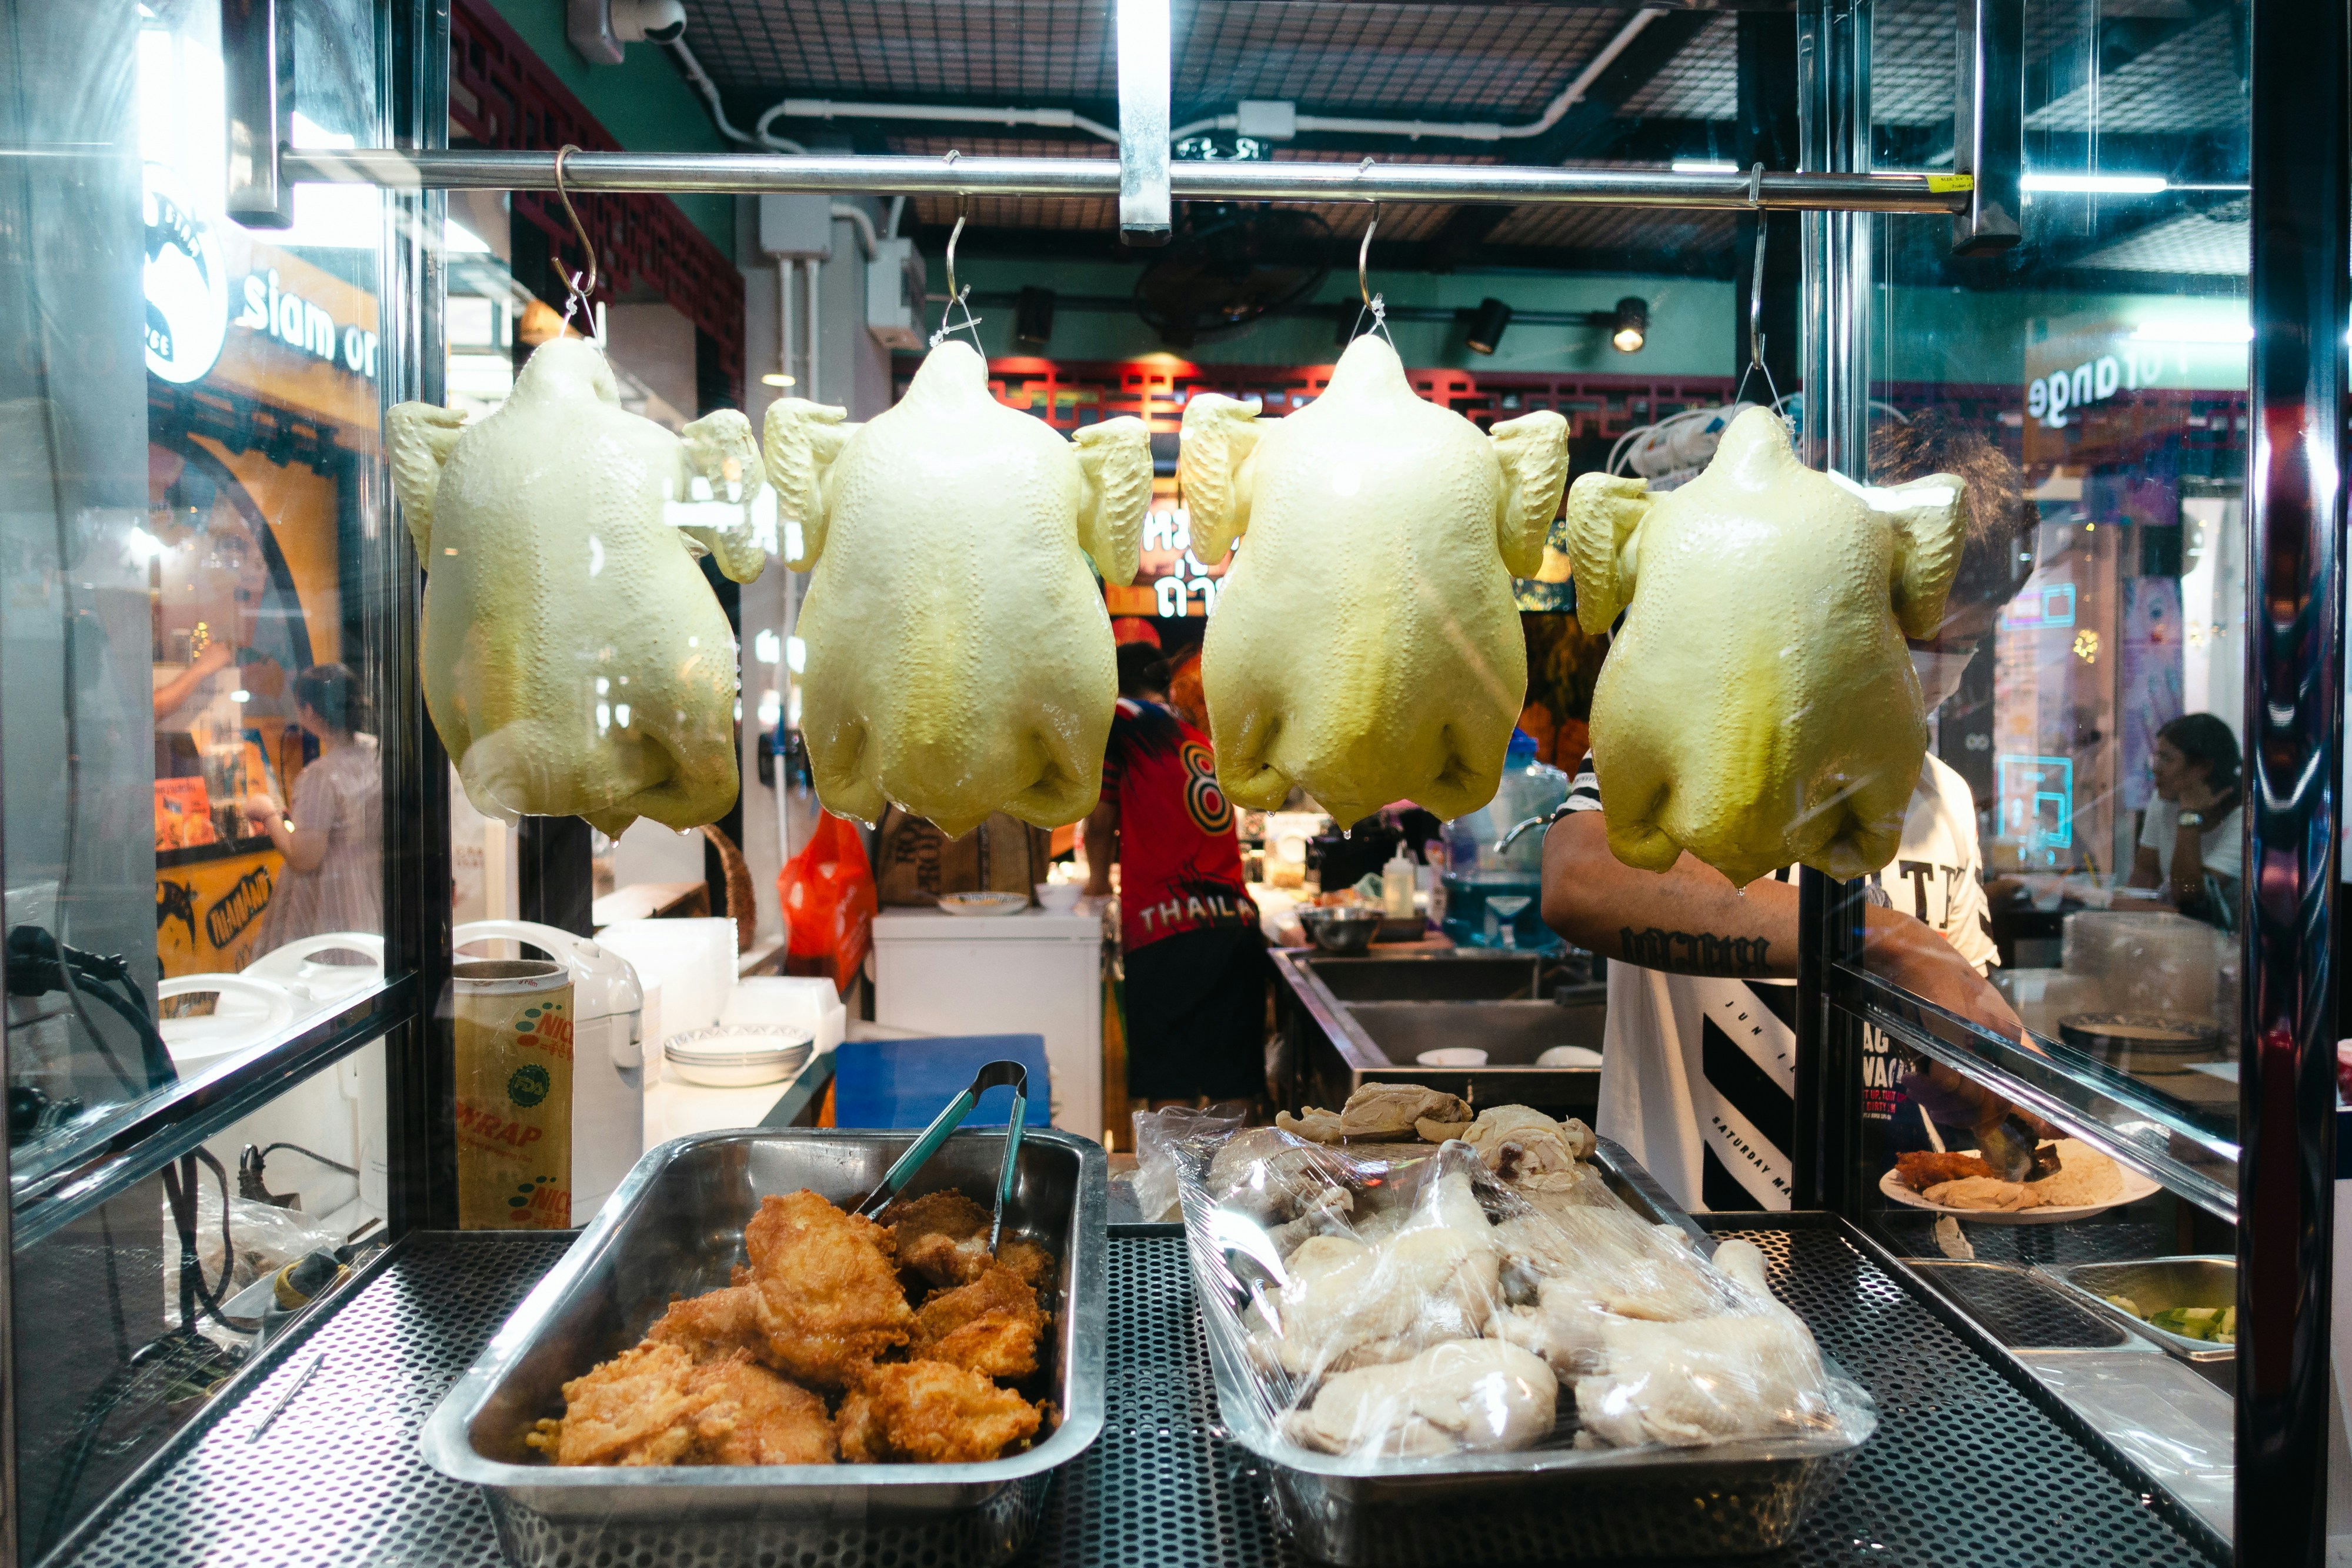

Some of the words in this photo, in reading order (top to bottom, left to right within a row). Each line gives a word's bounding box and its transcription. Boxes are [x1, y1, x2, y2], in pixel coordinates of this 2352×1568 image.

[243, 267, 336, 361] siam
[536, 1012, 573, 1046] NIC
[1725, 1000, 1763, 1035] JUN
[515, 1076, 543, 1096] FDA
[1712, 1117, 1771, 1174] SATURDAY
[1772, 1177, 1791, 1200] MA
